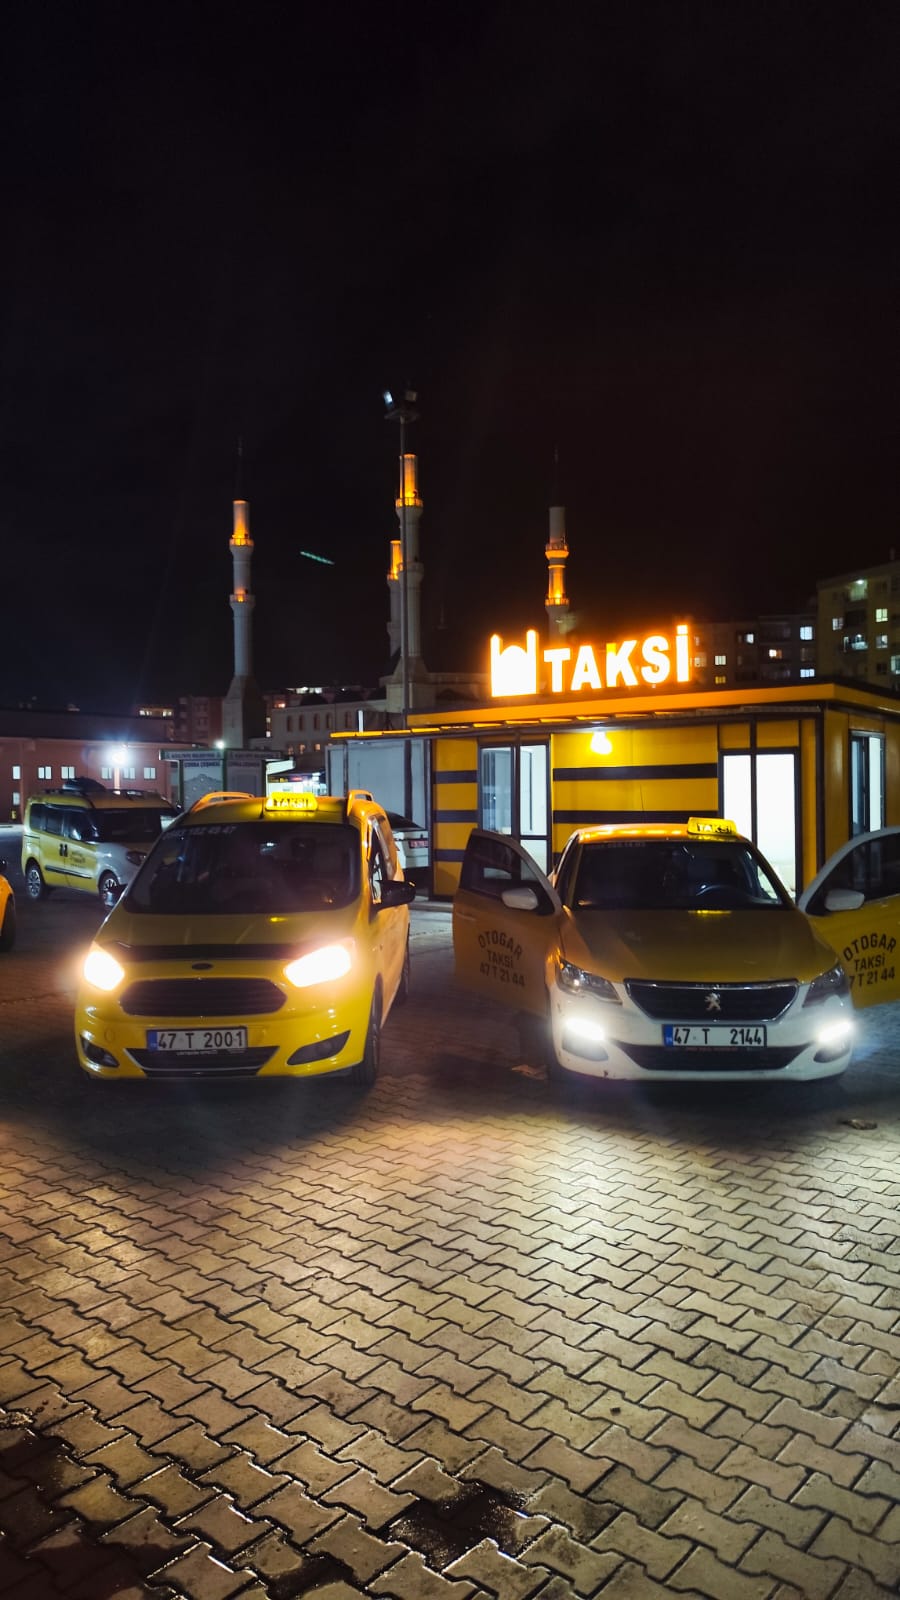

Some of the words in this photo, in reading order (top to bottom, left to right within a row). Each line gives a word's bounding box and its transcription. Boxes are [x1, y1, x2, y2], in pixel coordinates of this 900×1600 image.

[543, 624, 690, 692] TAKSİ
[478, 929, 523, 960] OTOGAR
[843, 932, 897, 961] OTOGAR
[487, 949, 513, 969] TAKSİ
[854, 951, 885, 972] TAKSİ
[858, 973, 865, 987] T
[881, 966, 895, 982] 44
[158, 1033, 177, 1049] 47
[185, 1032, 195, 1048] T
[204, 1031, 243, 1048] 2001
[674, 1028, 691, 1044] 47
[701, 1028, 710, 1044] T
[730, 1028, 762, 1045] 2144
